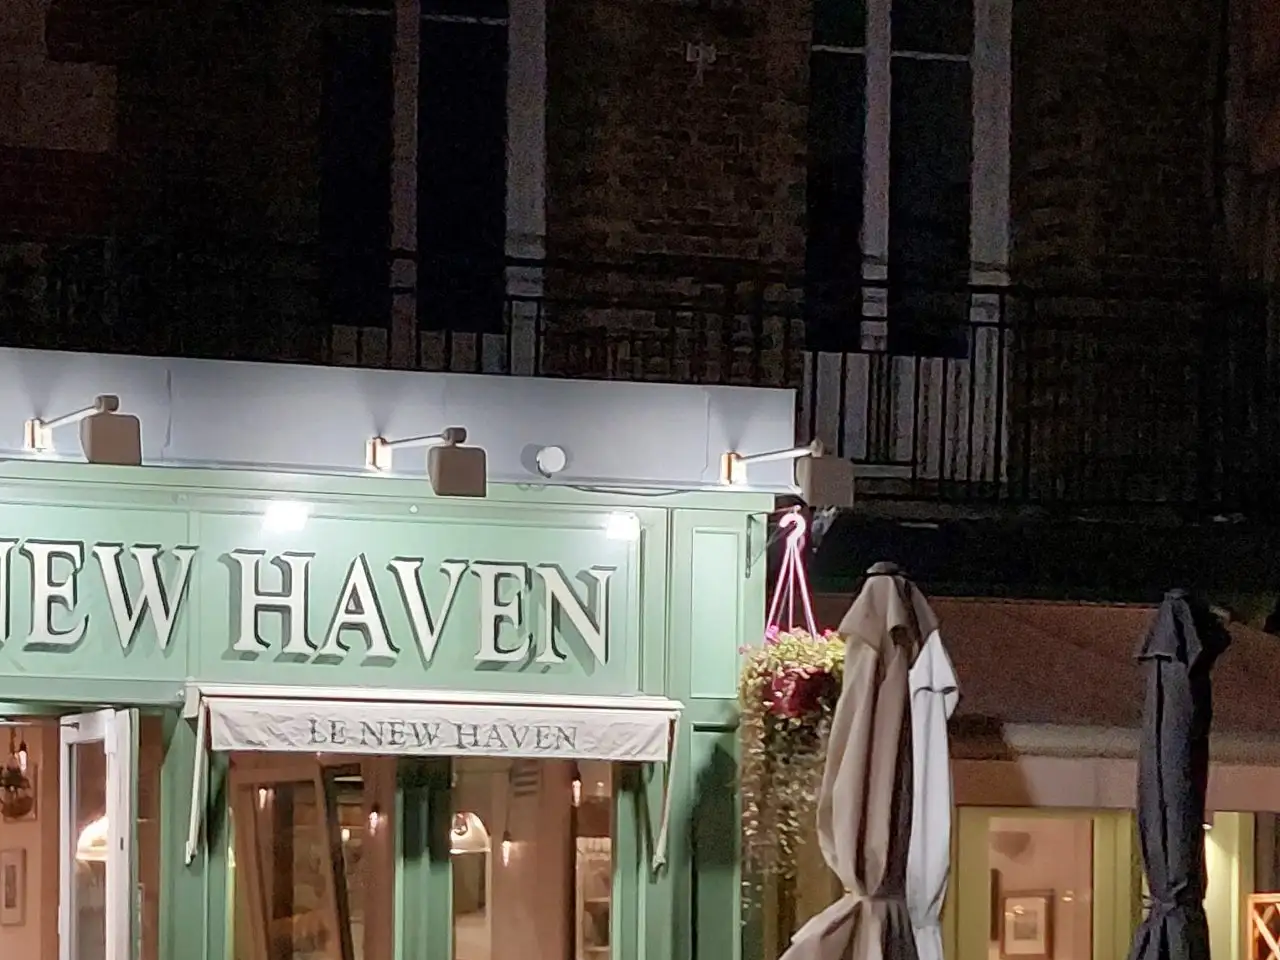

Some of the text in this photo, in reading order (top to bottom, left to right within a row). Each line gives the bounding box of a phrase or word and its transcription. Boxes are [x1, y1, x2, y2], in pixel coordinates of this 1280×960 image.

[219, 548, 617, 674] HAVEN
[308, 718, 578, 750] LE NEW HAVEN
